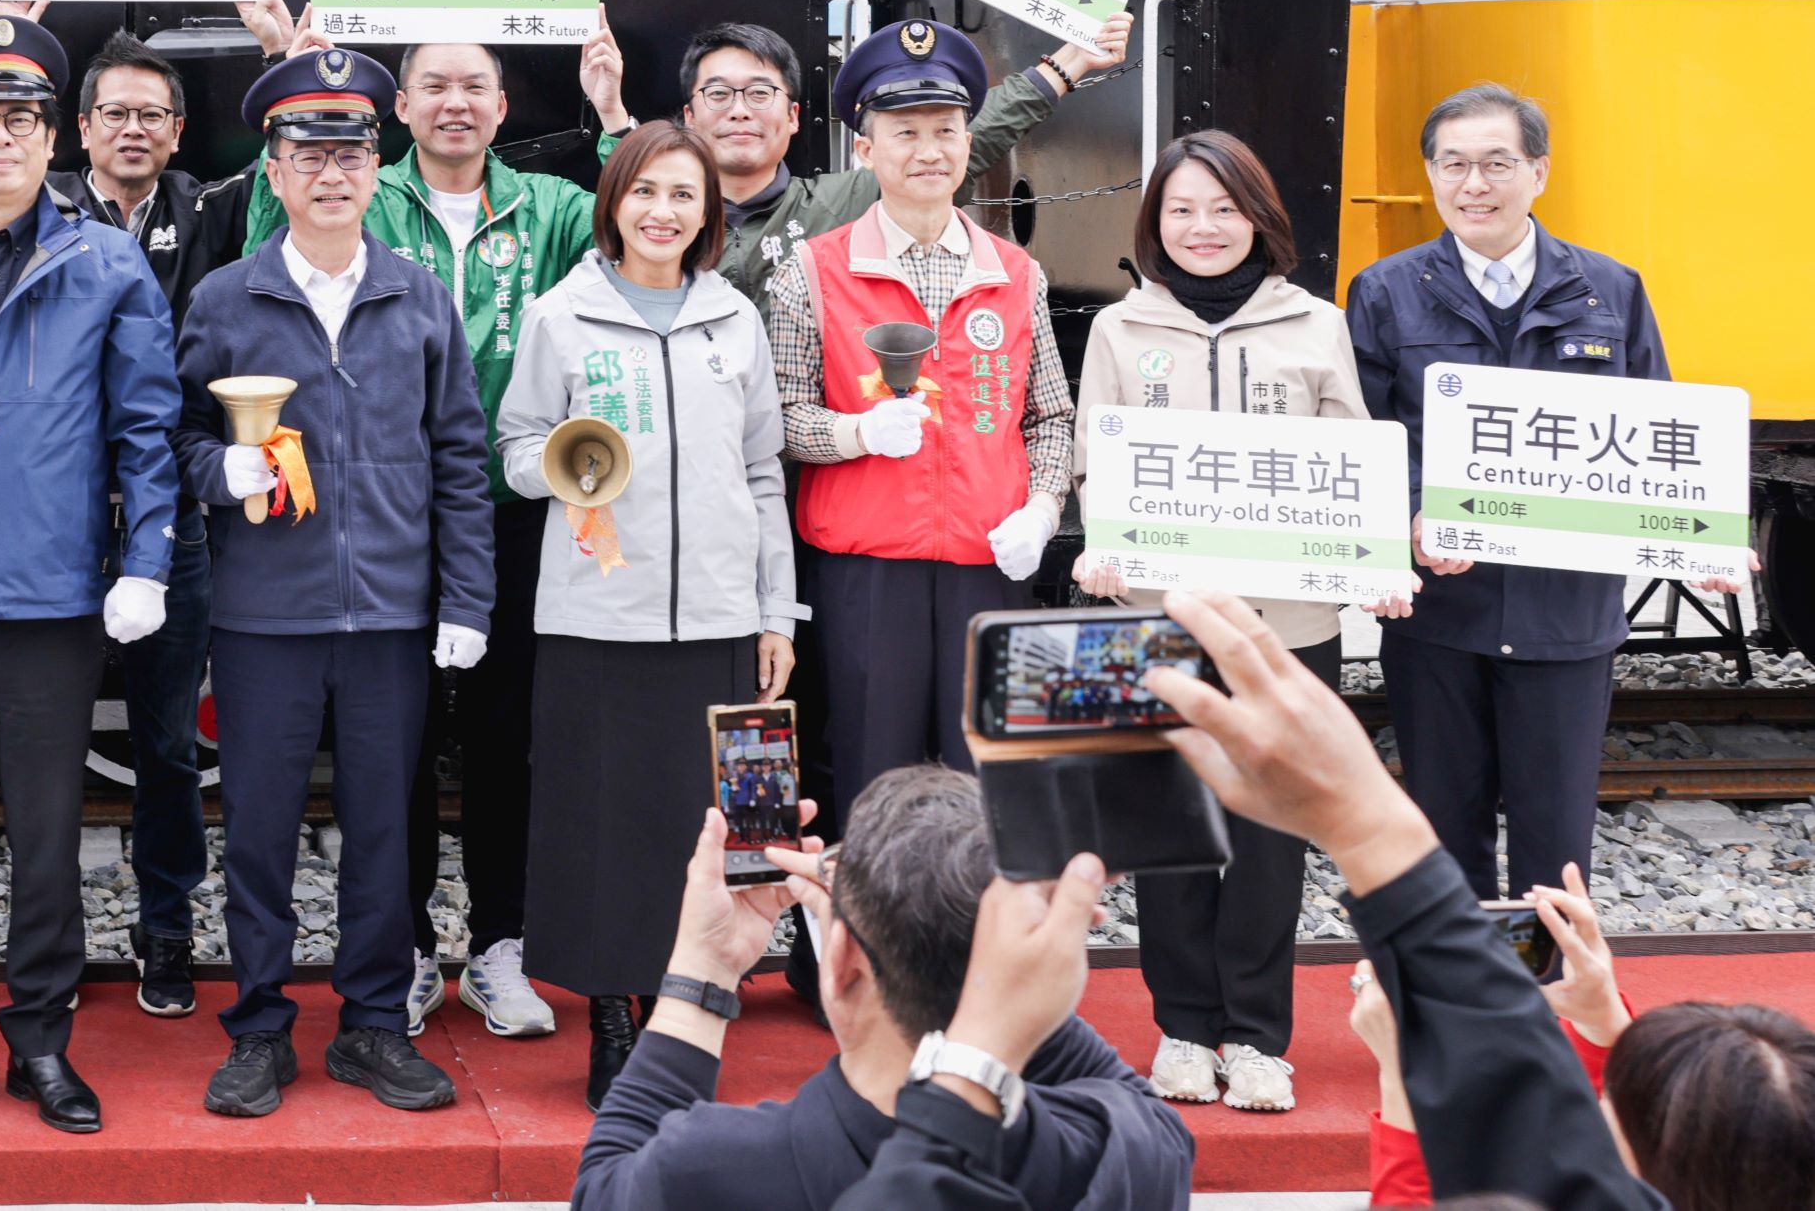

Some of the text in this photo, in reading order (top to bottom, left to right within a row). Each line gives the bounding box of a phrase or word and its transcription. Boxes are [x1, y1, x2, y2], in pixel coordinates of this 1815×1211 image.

[324, 14, 396, 36] 過去 Past
[503, 15, 589, 37] 未來 Future
[1026, 0, 1096, 44] 未來 Futur
[495, 274, 512, 352] 主任委員
[583, 349, 629, 433] 邱議
[632, 366, 655, 434] 立法委員
[1143, 383, 1170, 408] 湯
[1467, 404, 1701, 471] 百年火車
[1128, 442, 1361, 502] 百年車站
[1467, 462, 1705, 500] Century-Old train
[1129, 496, 1361, 527] Century-old Station
[1478, 500, 1527, 518] 100年
[1640, 515, 1689, 532] 100年
[1141, 531, 1189, 547] 100年
[1302, 542, 1351, 558] 100年
[1437, 527, 1517, 557] 過去 Past
[1637, 546, 1735, 576] 未來 Future
[1152, 570, 1180, 583] Past
[1300, 572, 1347, 593] 未來
